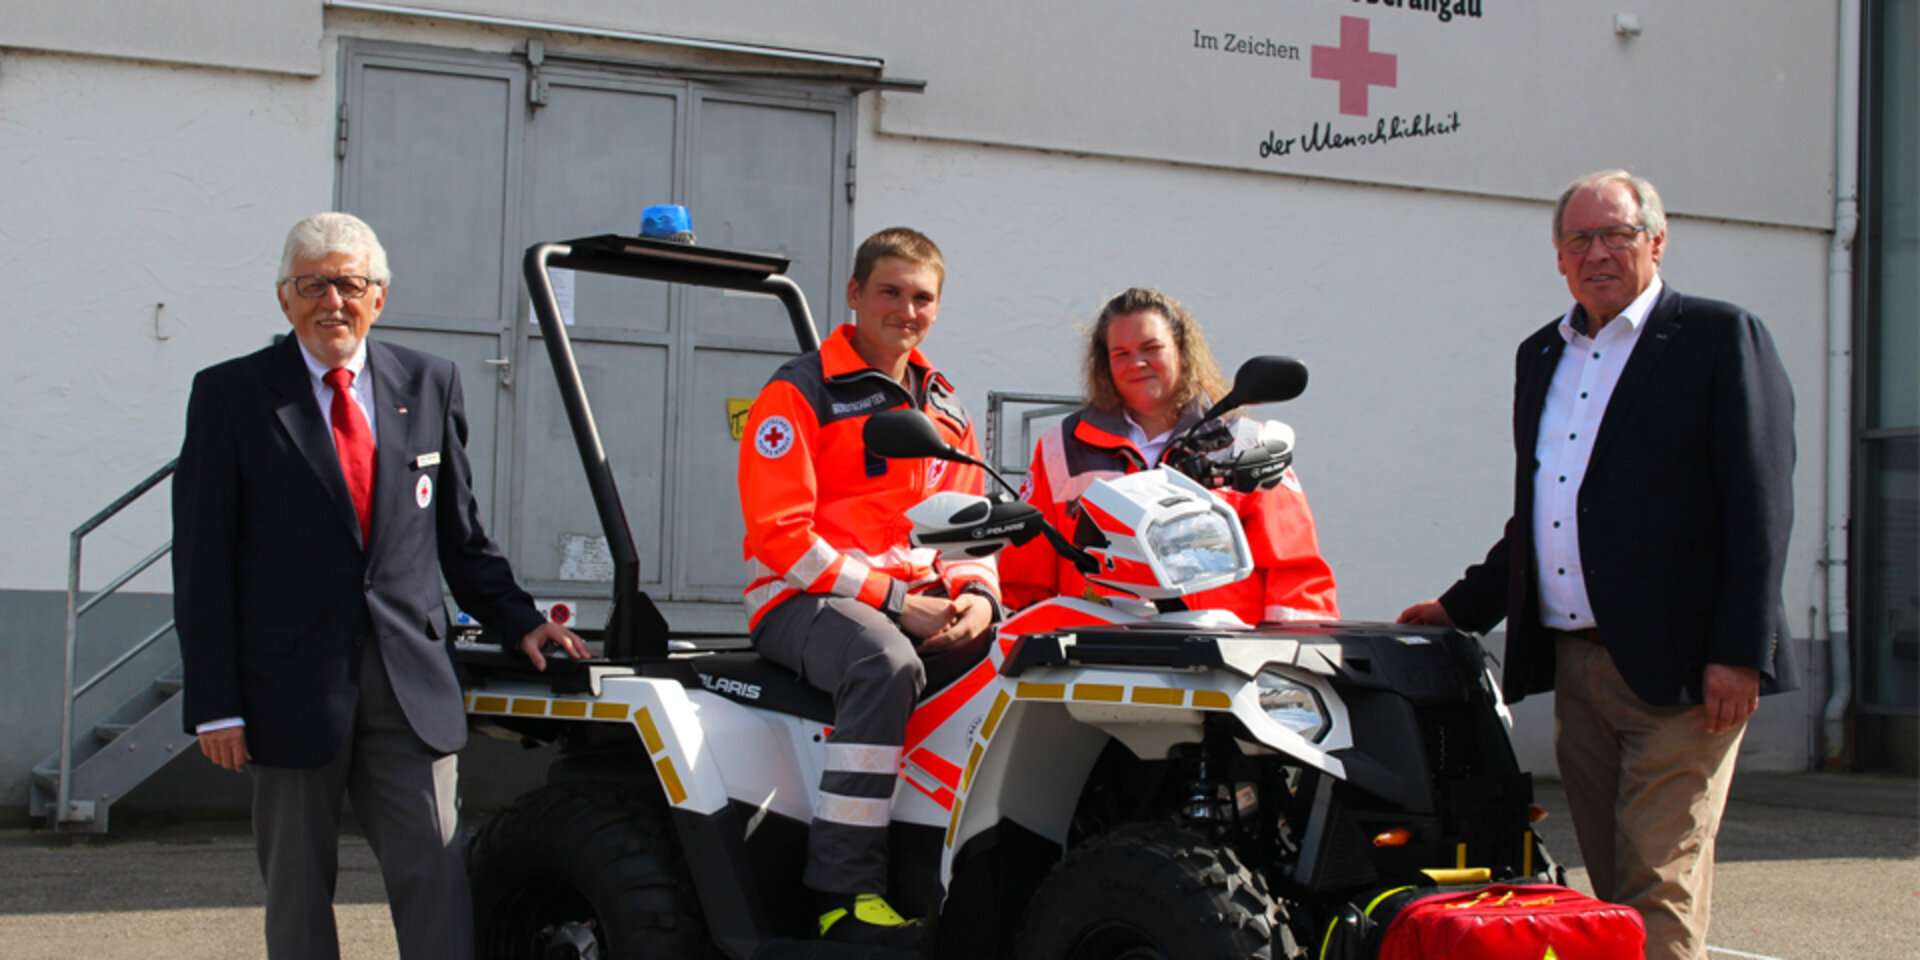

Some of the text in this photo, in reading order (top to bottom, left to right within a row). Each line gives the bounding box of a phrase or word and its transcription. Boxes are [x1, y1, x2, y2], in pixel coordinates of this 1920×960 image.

[1193, 30, 1300, 60] Im Zeichen
[1259, 112, 1461, 158] der Menschlichkeit
[986, 521, 1026, 536] POLARIS
